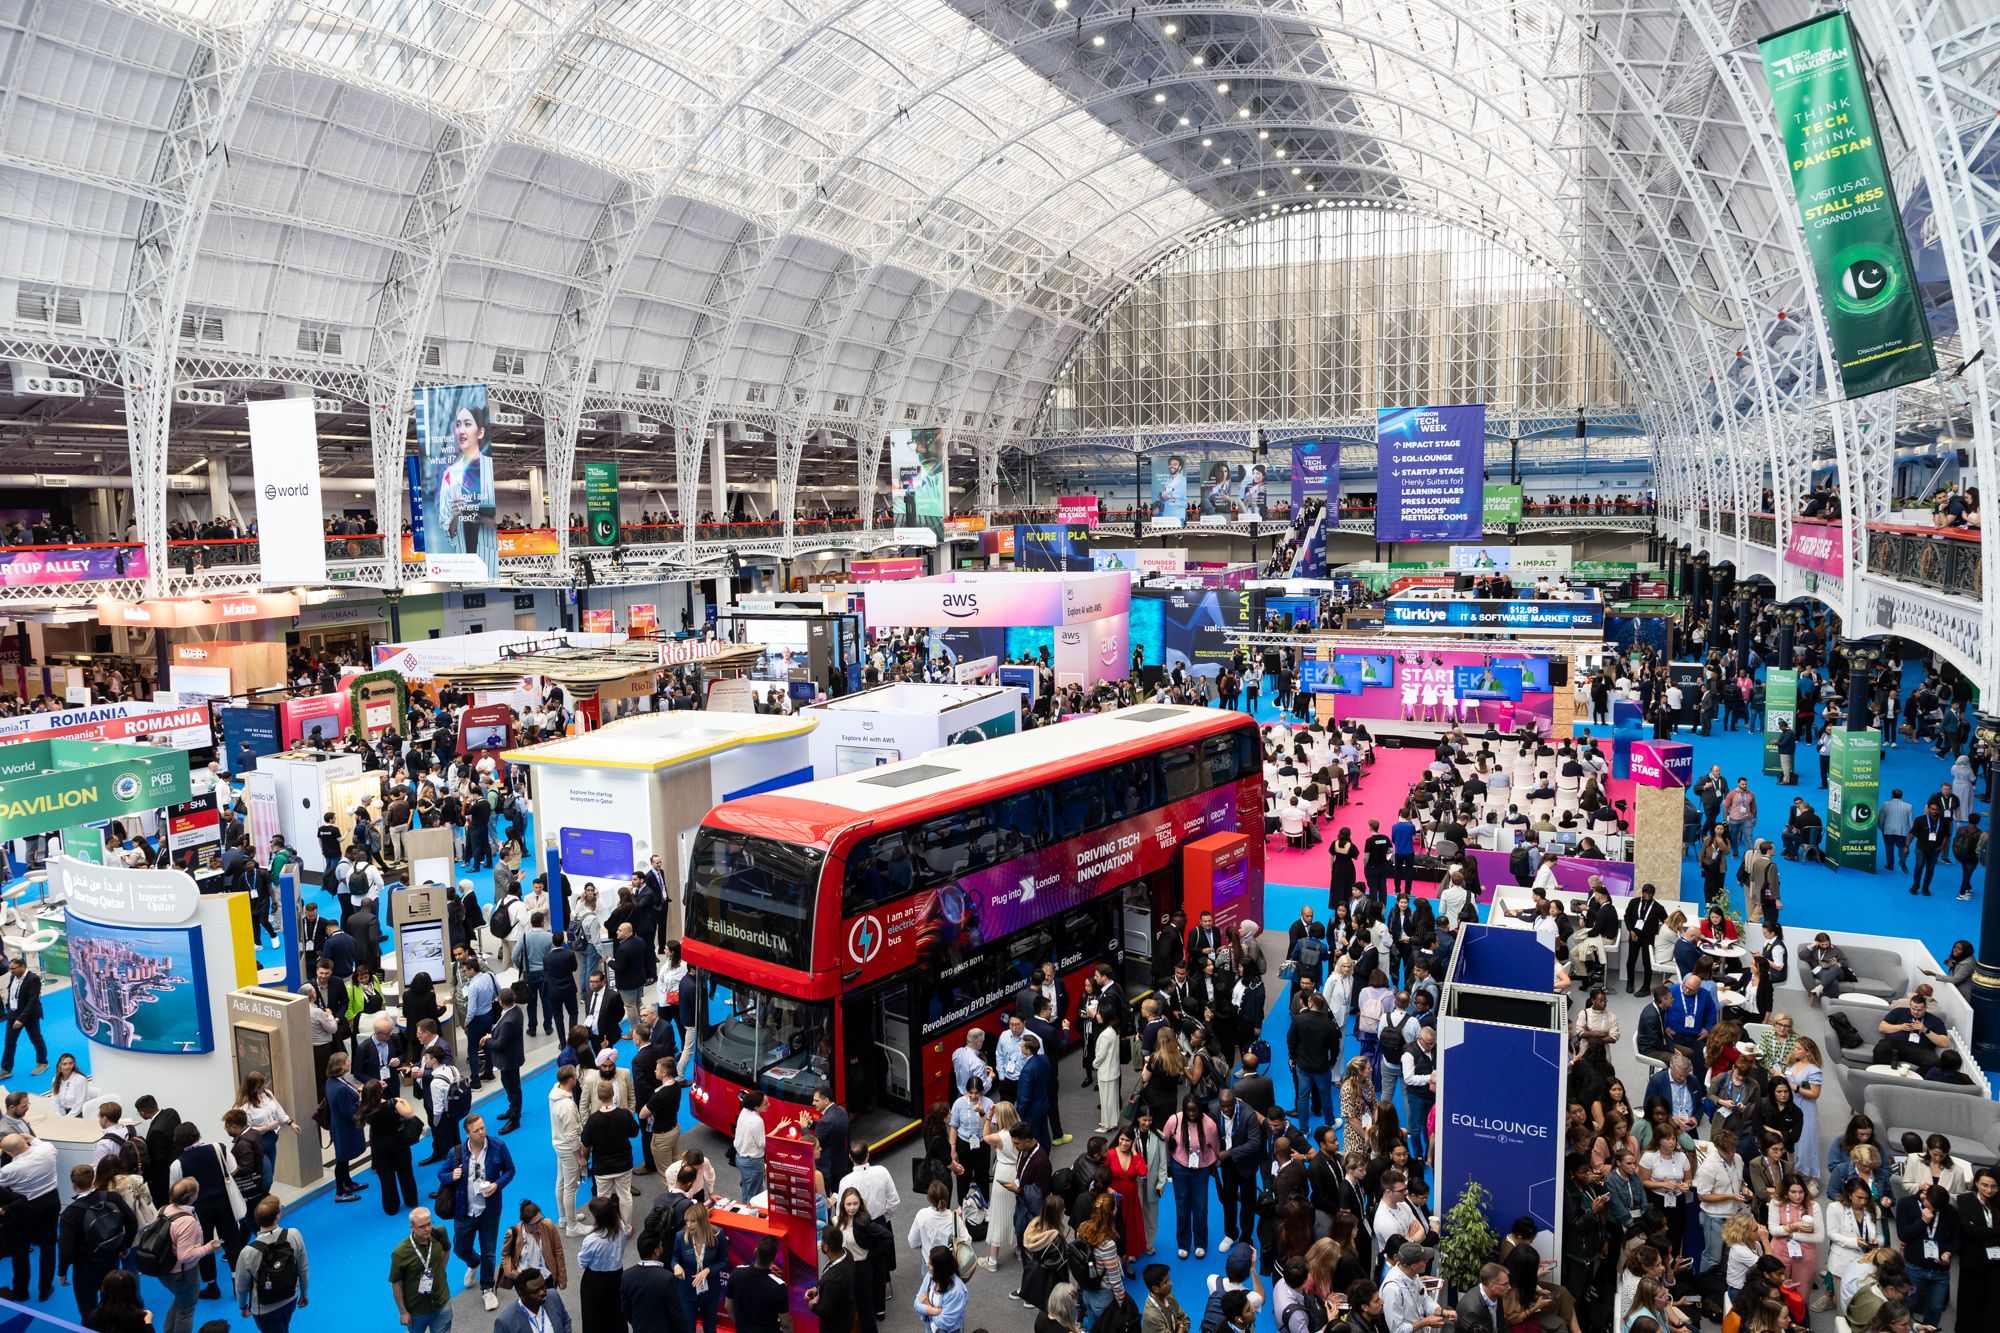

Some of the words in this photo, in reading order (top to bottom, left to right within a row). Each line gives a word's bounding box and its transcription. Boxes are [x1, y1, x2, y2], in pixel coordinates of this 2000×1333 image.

[1794, 48, 1848, 73] PAKISTAN
[1793, 96, 1852, 124] THINK
[1801, 112, 1849, 136] TECH
[1800, 125, 1857, 153] THINK
[1793, 136, 1873, 171] PAKISTAN
[1811, 183, 1837, 202] VISIT
[1838, 180, 1852, 194] US
[1853, 177, 1871, 190] AT:
[1805, 199, 1852, 220] STALL
[1854, 187, 1884, 206] #55
[1814, 211, 1852, 229] GRAND
[1853, 203, 1881, 220] HALL
[1857, 343, 1884, 355] Discover
[1415, 417, 1438, 425] TECH
[1421, 424, 1447, 432] WEEK
[431, 434, 454, 443] started
[1402, 441, 1433, 449] IMPACT
[1435, 440, 1461, 448] STAGE
[1402, 454, 1453, 463] EQL:LOUNGE
[1401, 478, 1424, 487] (Henly
[1426, 477, 1448, 485] Suites
[1450, 477, 1464, 485] for)
[278, 483, 309, 498] world
[45, 560, 90, 573] ALLEY
[223, 602, 257, 617] Malta
[1067, 606, 1081, 617] Explore
[1393, 607, 1446, 623] Türkiye
[1479, 614, 1529, 622] SOFTWARE
[1531, 614, 1570, 622] MARKET
[1572, 615, 1592, 623] SIZE
[1509, 606, 1539, 614] $12.9B
[371, 688, 395, 697] remote
[50, 706, 128, 727] ROMANIA
[124, 711, 203, 734] ROMANIA
[1631, 753, 1643, 763] UP
[1664, 756, 1692, 769] START
[1, 761, 36, 775] World
[1631, 763, 1660, 778] STAGE
[252, 792, 264, 800] Hello
[265, 793, 274, 801] UK
[1210, 807, 1227, 820] GROW
[1155, 822, 1172, 833] LONDON
[1184, 816, 1205, 830] LONDON
[1156, 829, 1172, 841] TECH
[1160, 835, 1177, 849] WEEK
[1076, 840, 1116, 867] DRIVING
[1117, 831, 1141, 852] TECH
[1077, 850, 1134, 883] INNOVATION
[89, 880, 101, 891] من
[991, 892, 1007, 906] Plug
[1008, 887, 1022, 901] into
[1035, 872, 1060, 890] London
[73, 889, 99, 907] Startup
[99, 896, 125, 909] Qatar
[138, 892, 168, 902] Invest
[147, 902, 176, 912] Qatar
[891, 911, 903, 922] am
[904, 907, 914, 918] an
[887, 918, 916, 935] electric
[888, 934, 902, 947] bus
[940, 968, 953, 979] BYD
[969, 954, 984, 968] BD11
[1061, 951, 1083, 969] Electric
[232, 999, 250, 1013] Ask
[251, 1003, 282, 1019] Ai.Sha
[922, 1004, 970, 1034] Revolutionary
[970, 998, 985, 1013] BYD
[985, 988, 1004, 1005] Blade
[1005, 979, 1028, 995] Battery
[1451, 1113, 1548, 1138] EQL:LOUNGE
